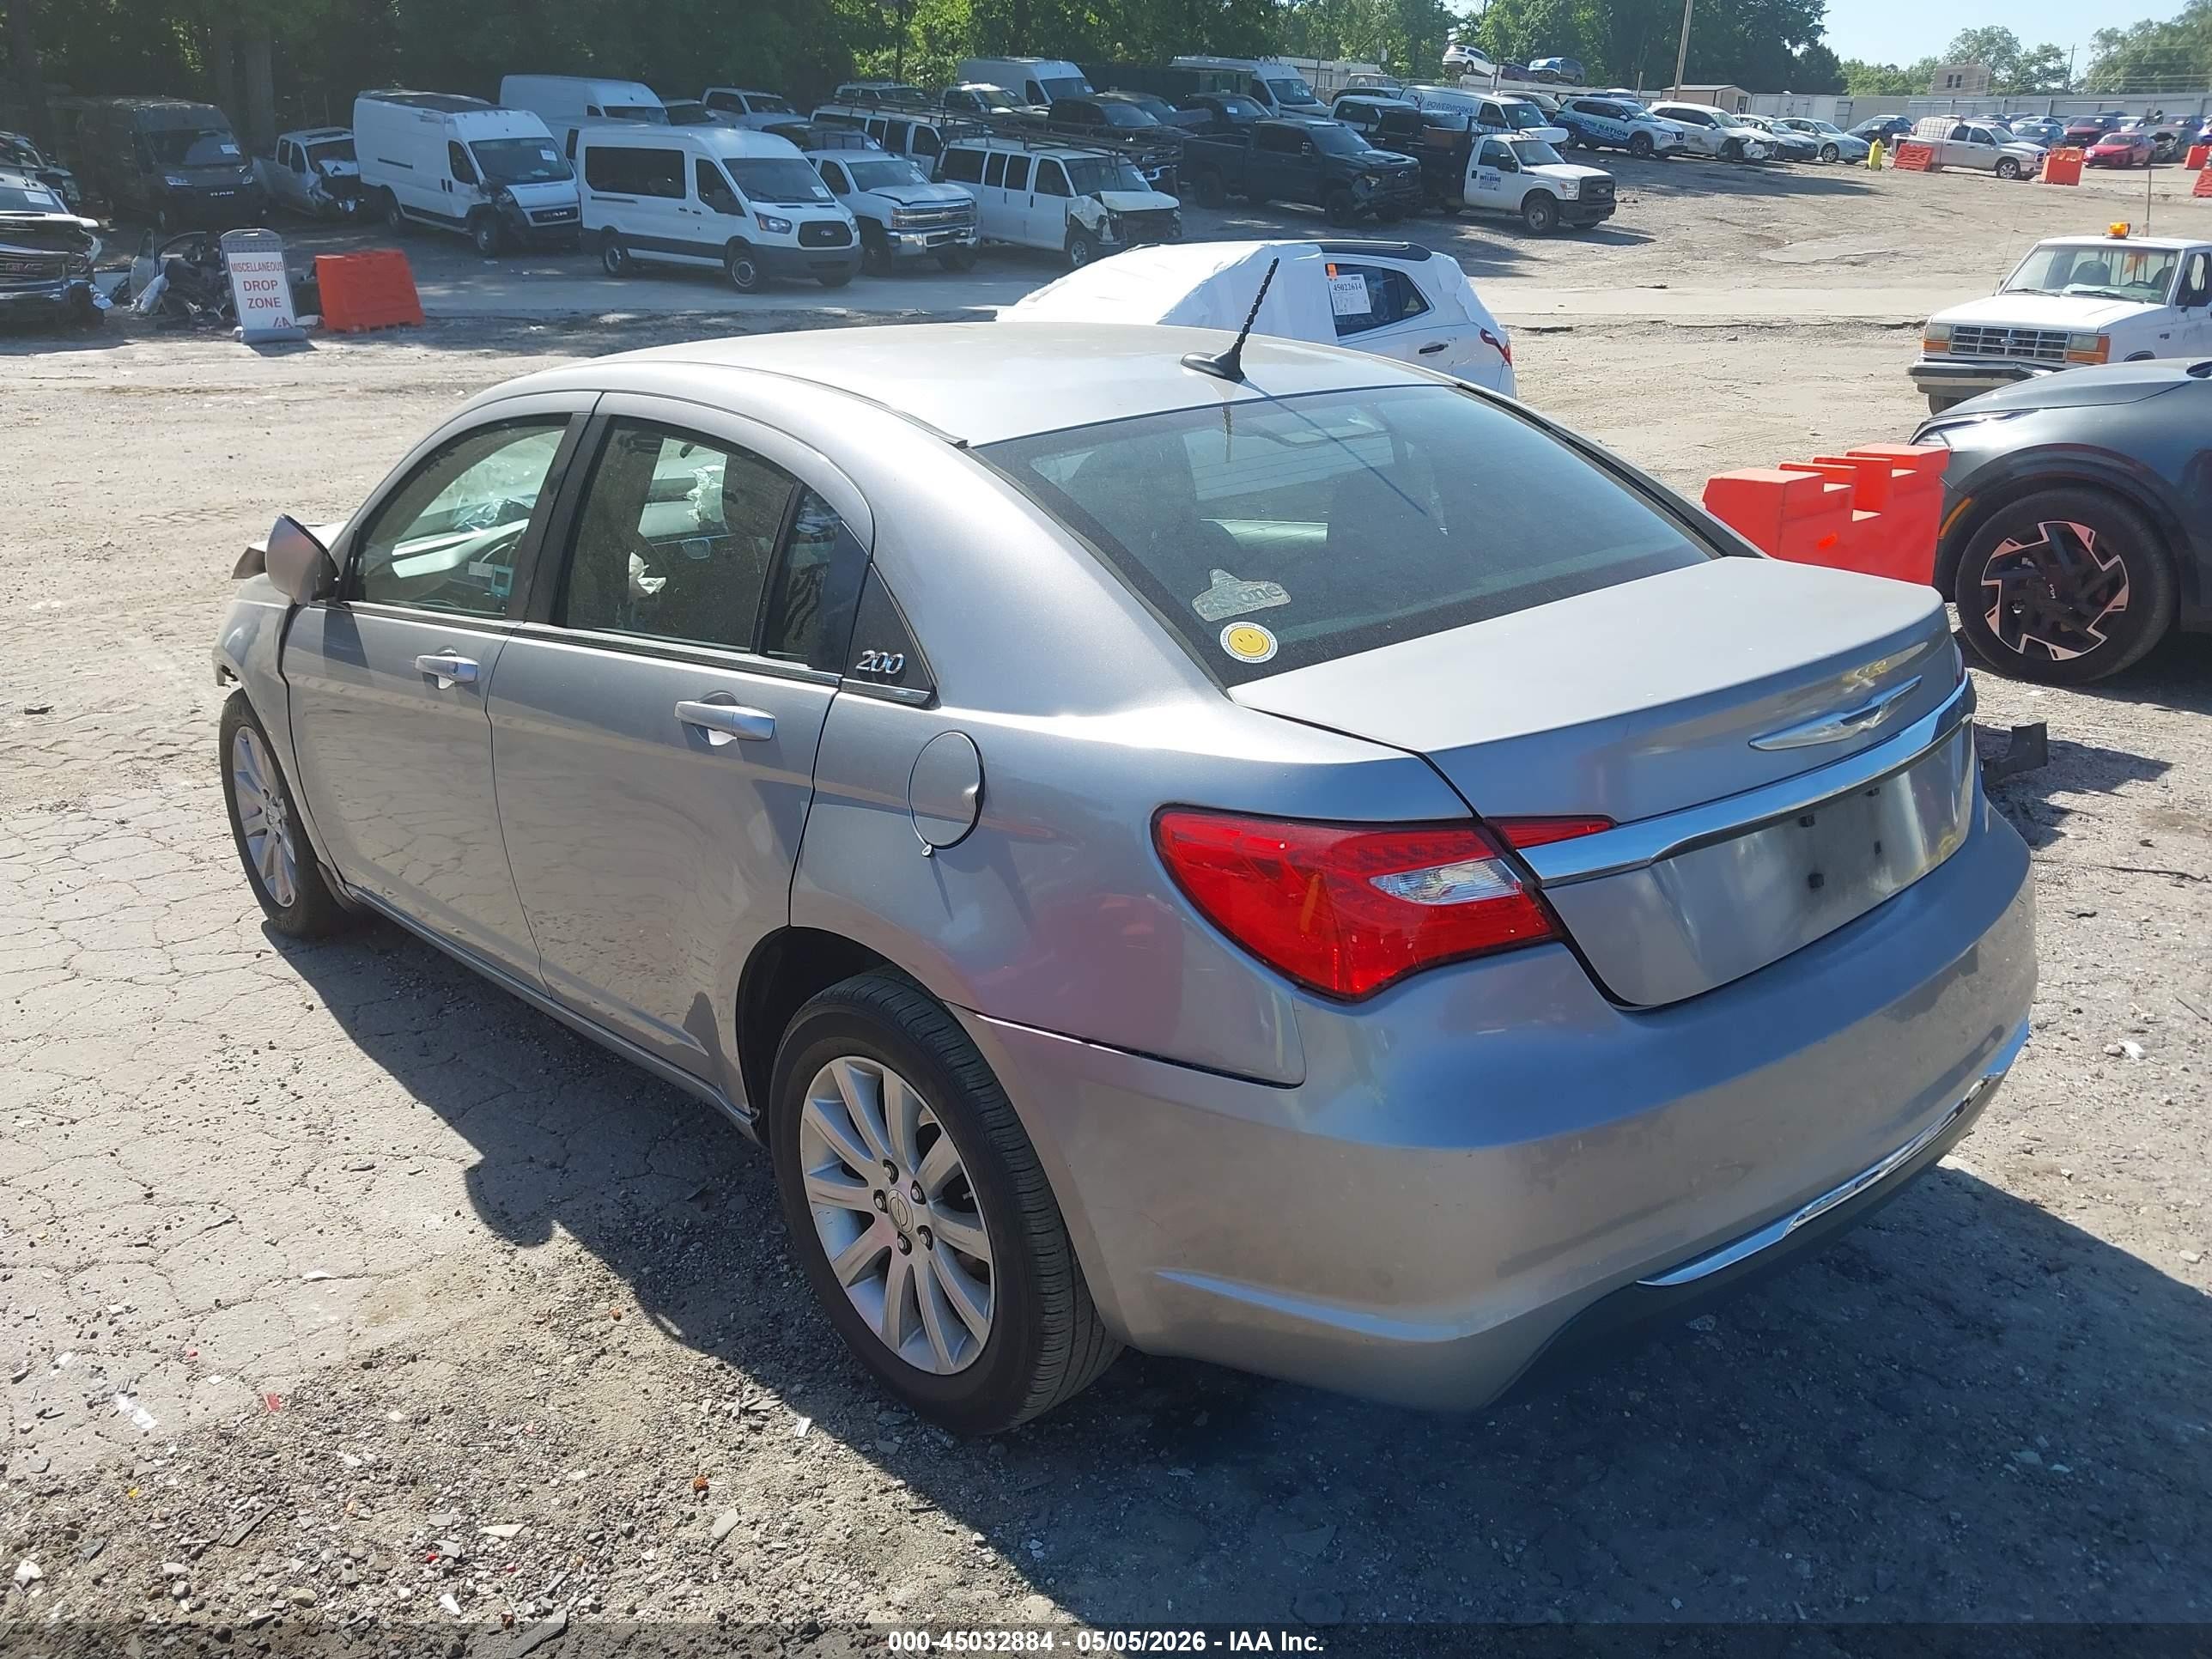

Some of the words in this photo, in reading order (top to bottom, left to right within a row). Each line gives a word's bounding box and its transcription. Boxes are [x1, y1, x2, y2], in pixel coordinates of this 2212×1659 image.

[1427, 100, 1474, 114] POWERWORKS
[1599, 123, 1629, 138] NATION
[231, 261, 284, 272] MISCELLANEOUS
[243, 280, 278, 291] DROP
[247, 297, 282, 309] ZONE
[855, 650, 904, 674] 200
